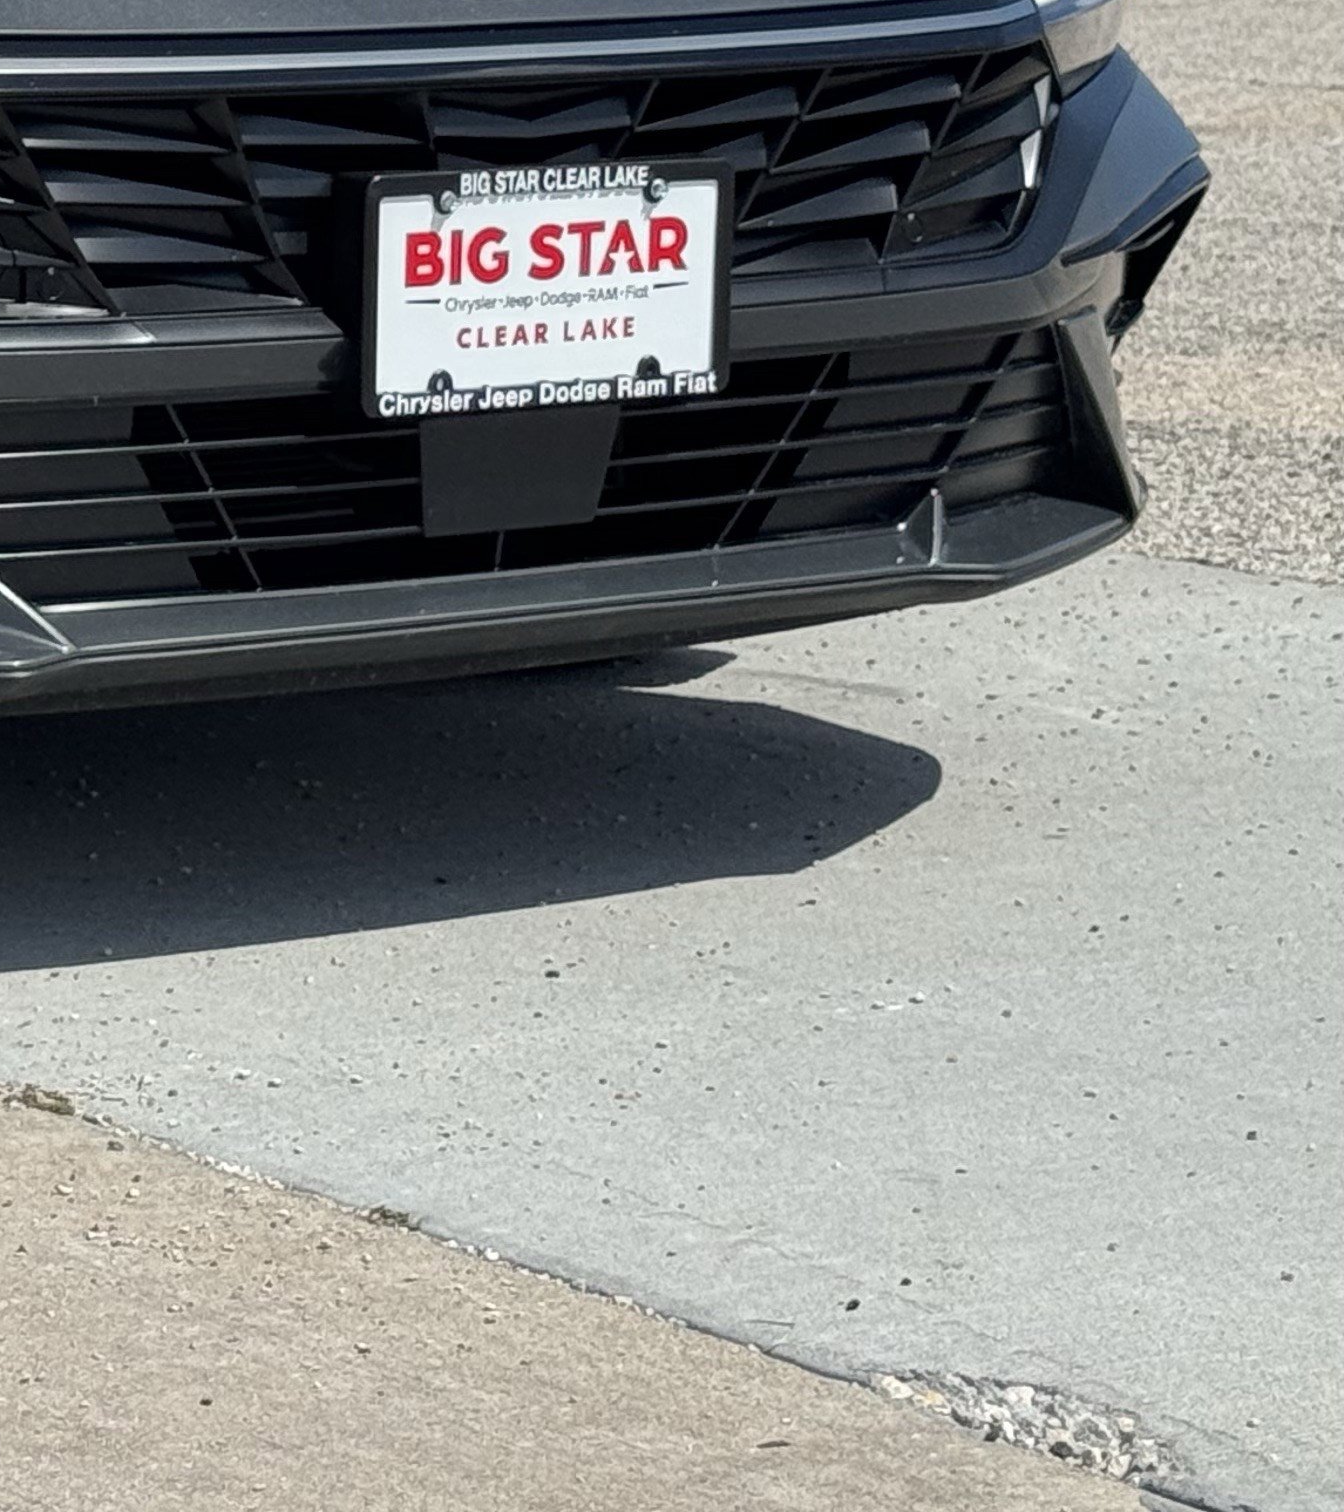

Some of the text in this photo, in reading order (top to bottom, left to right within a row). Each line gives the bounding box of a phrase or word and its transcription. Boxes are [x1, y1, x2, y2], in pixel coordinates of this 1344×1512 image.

[460, 165, 650, 196] BIG STAR CLEAR LAKE
[404, 215, 688, 288] BIG STAR
[456, 315, 635, 349] CLEAR LAKE
[378, 371, 718, 417] Chrysler Jeep Dodge Ram Fiat
